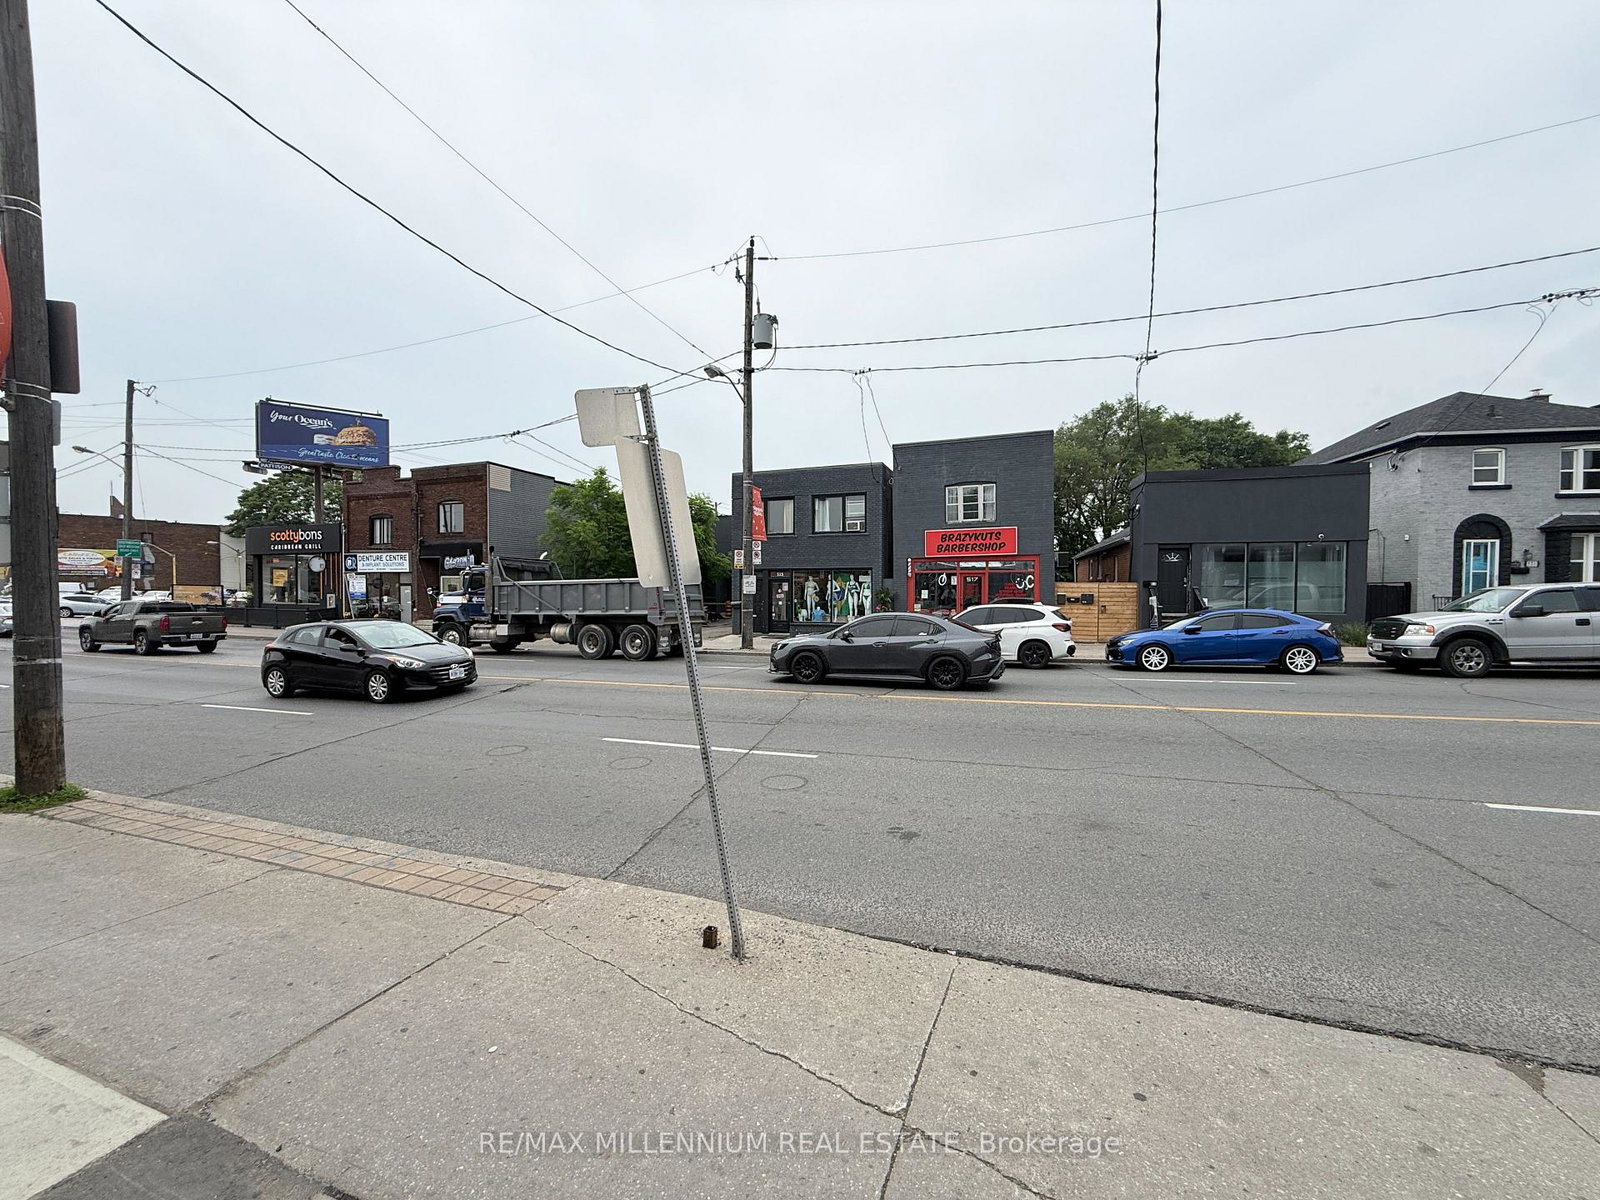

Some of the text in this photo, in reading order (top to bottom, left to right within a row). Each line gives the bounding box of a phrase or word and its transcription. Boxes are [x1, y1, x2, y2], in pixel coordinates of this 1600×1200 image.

[270, 410, 333, 428] Your Ocean's
[270, 529, 323, 543] scottybons
[940, 531, 1002, 543] BRAZYKUTS
[936, 542, 1006, 553] BARBERSHOP
[358, 554, 383, 562] DENTURE
